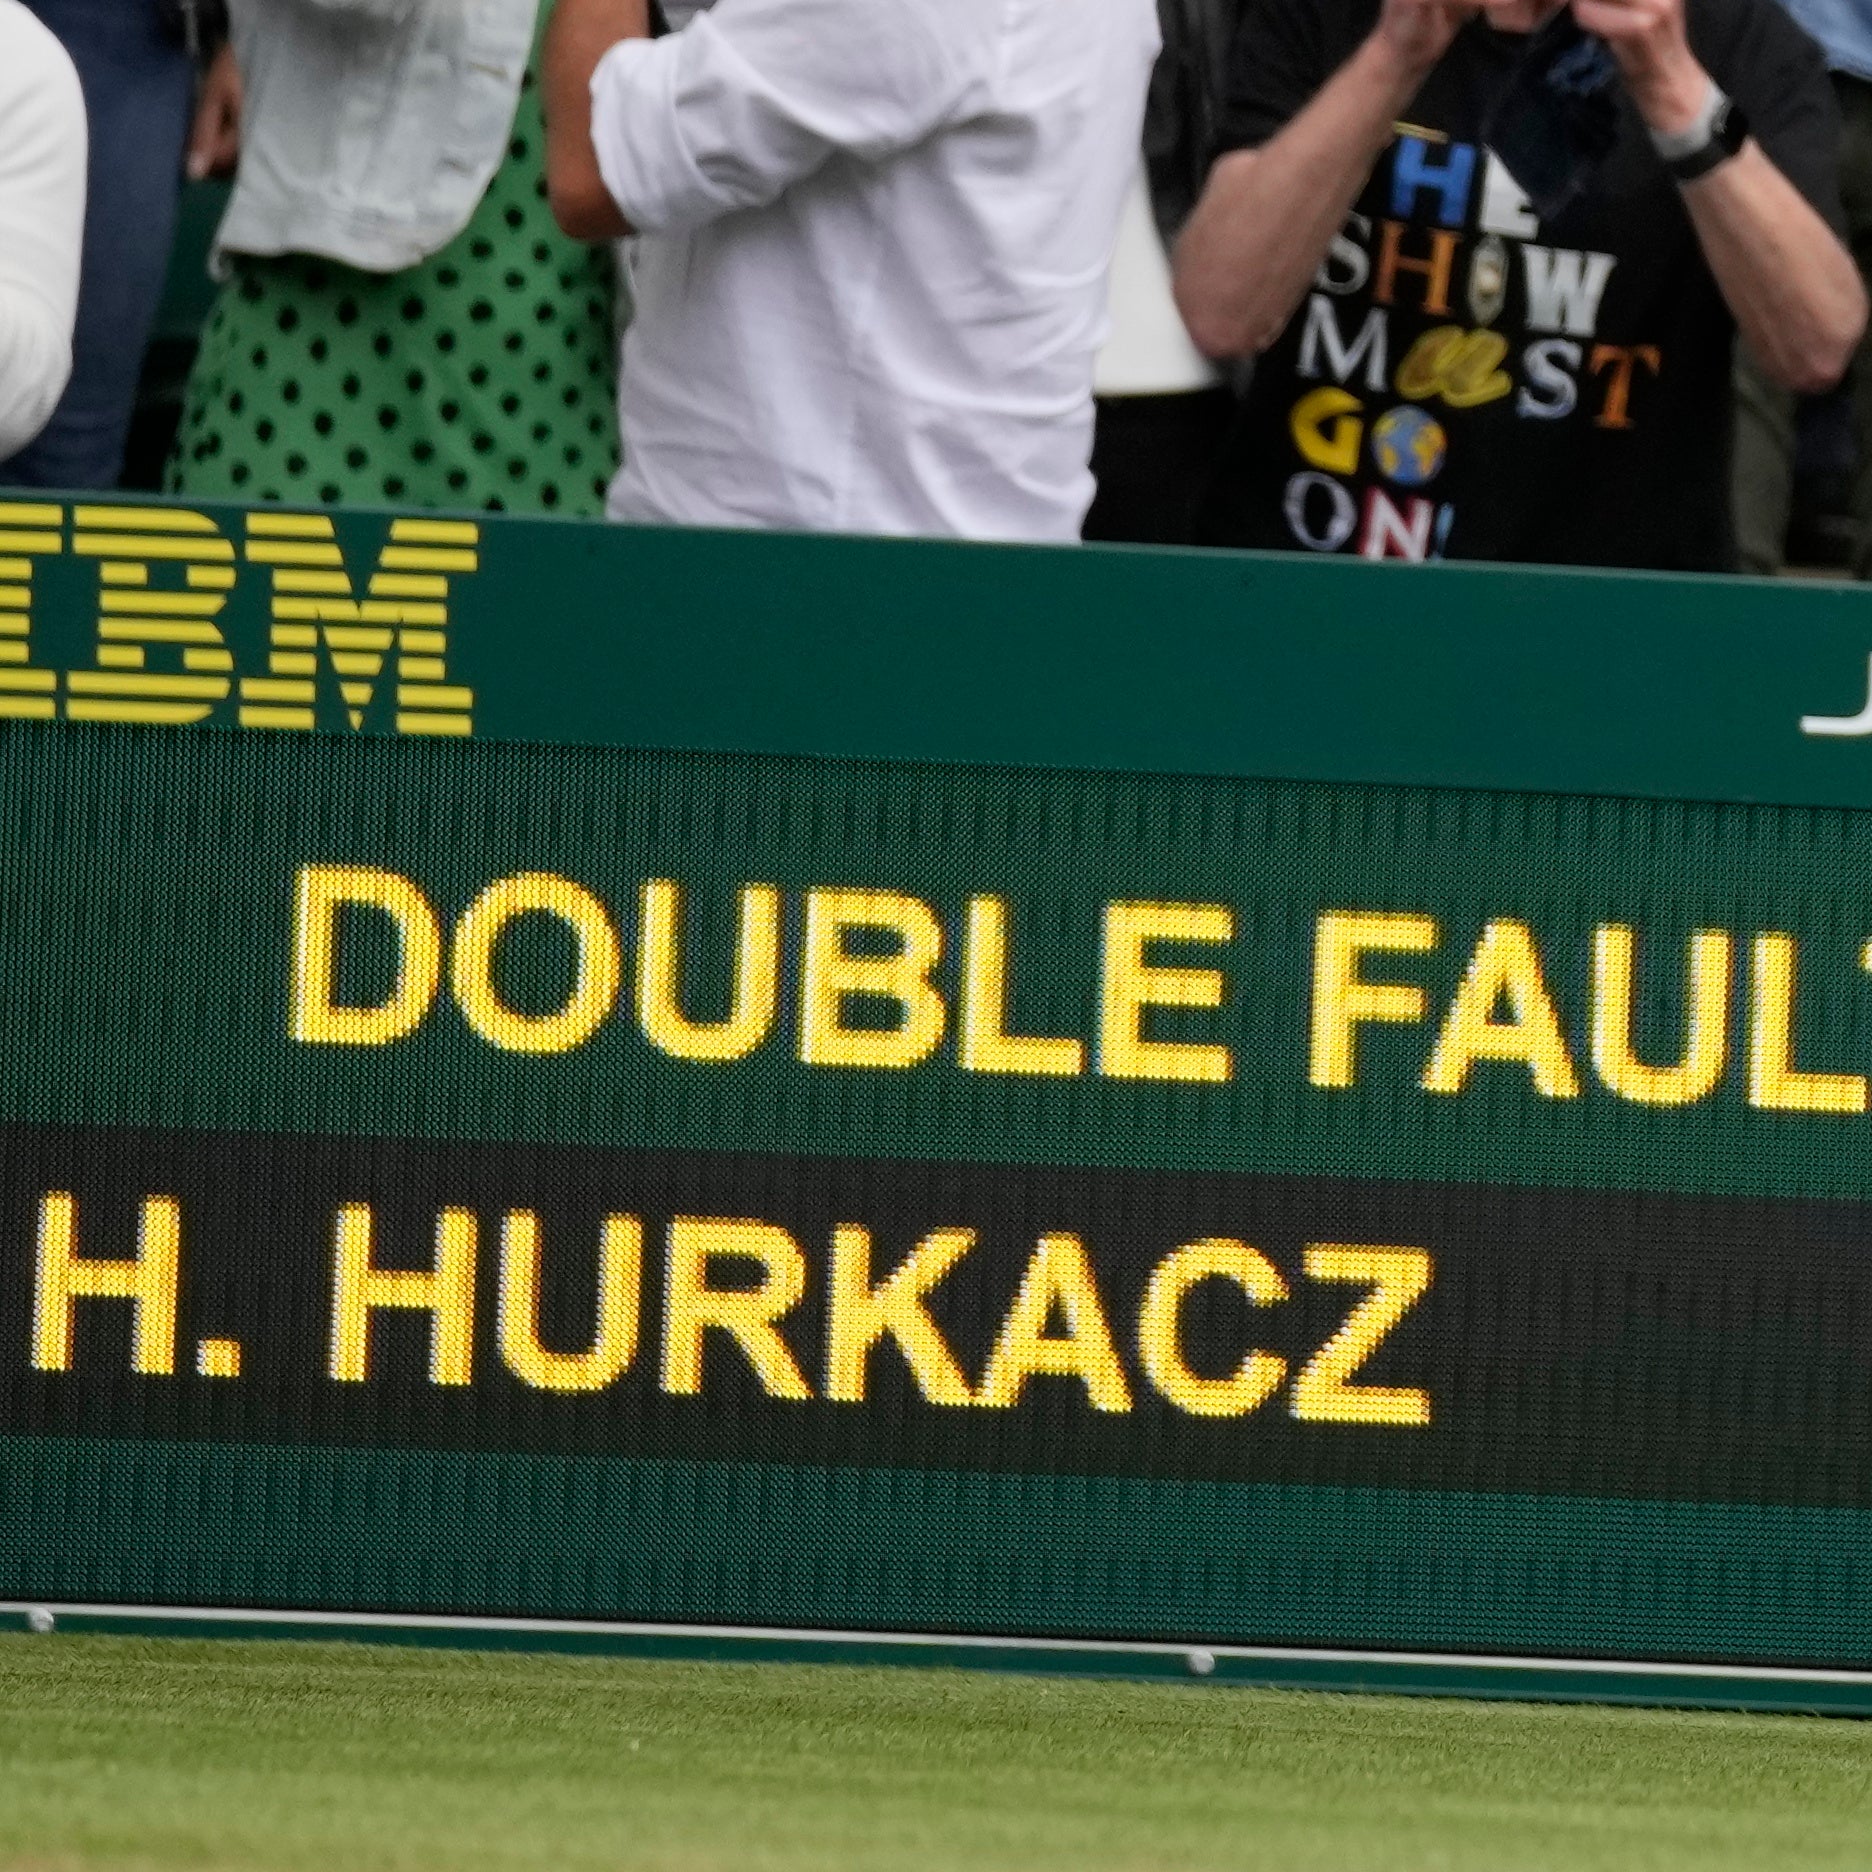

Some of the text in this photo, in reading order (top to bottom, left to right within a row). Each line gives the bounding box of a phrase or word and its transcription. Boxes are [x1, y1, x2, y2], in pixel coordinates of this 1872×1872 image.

[0, 502, 479, 737] IBM
[287, 862, 1234, 1083] DOUBLE
[31, 1190, 242, 1379] H.
[329, 1201, 1434, 1425] HURKACZ
